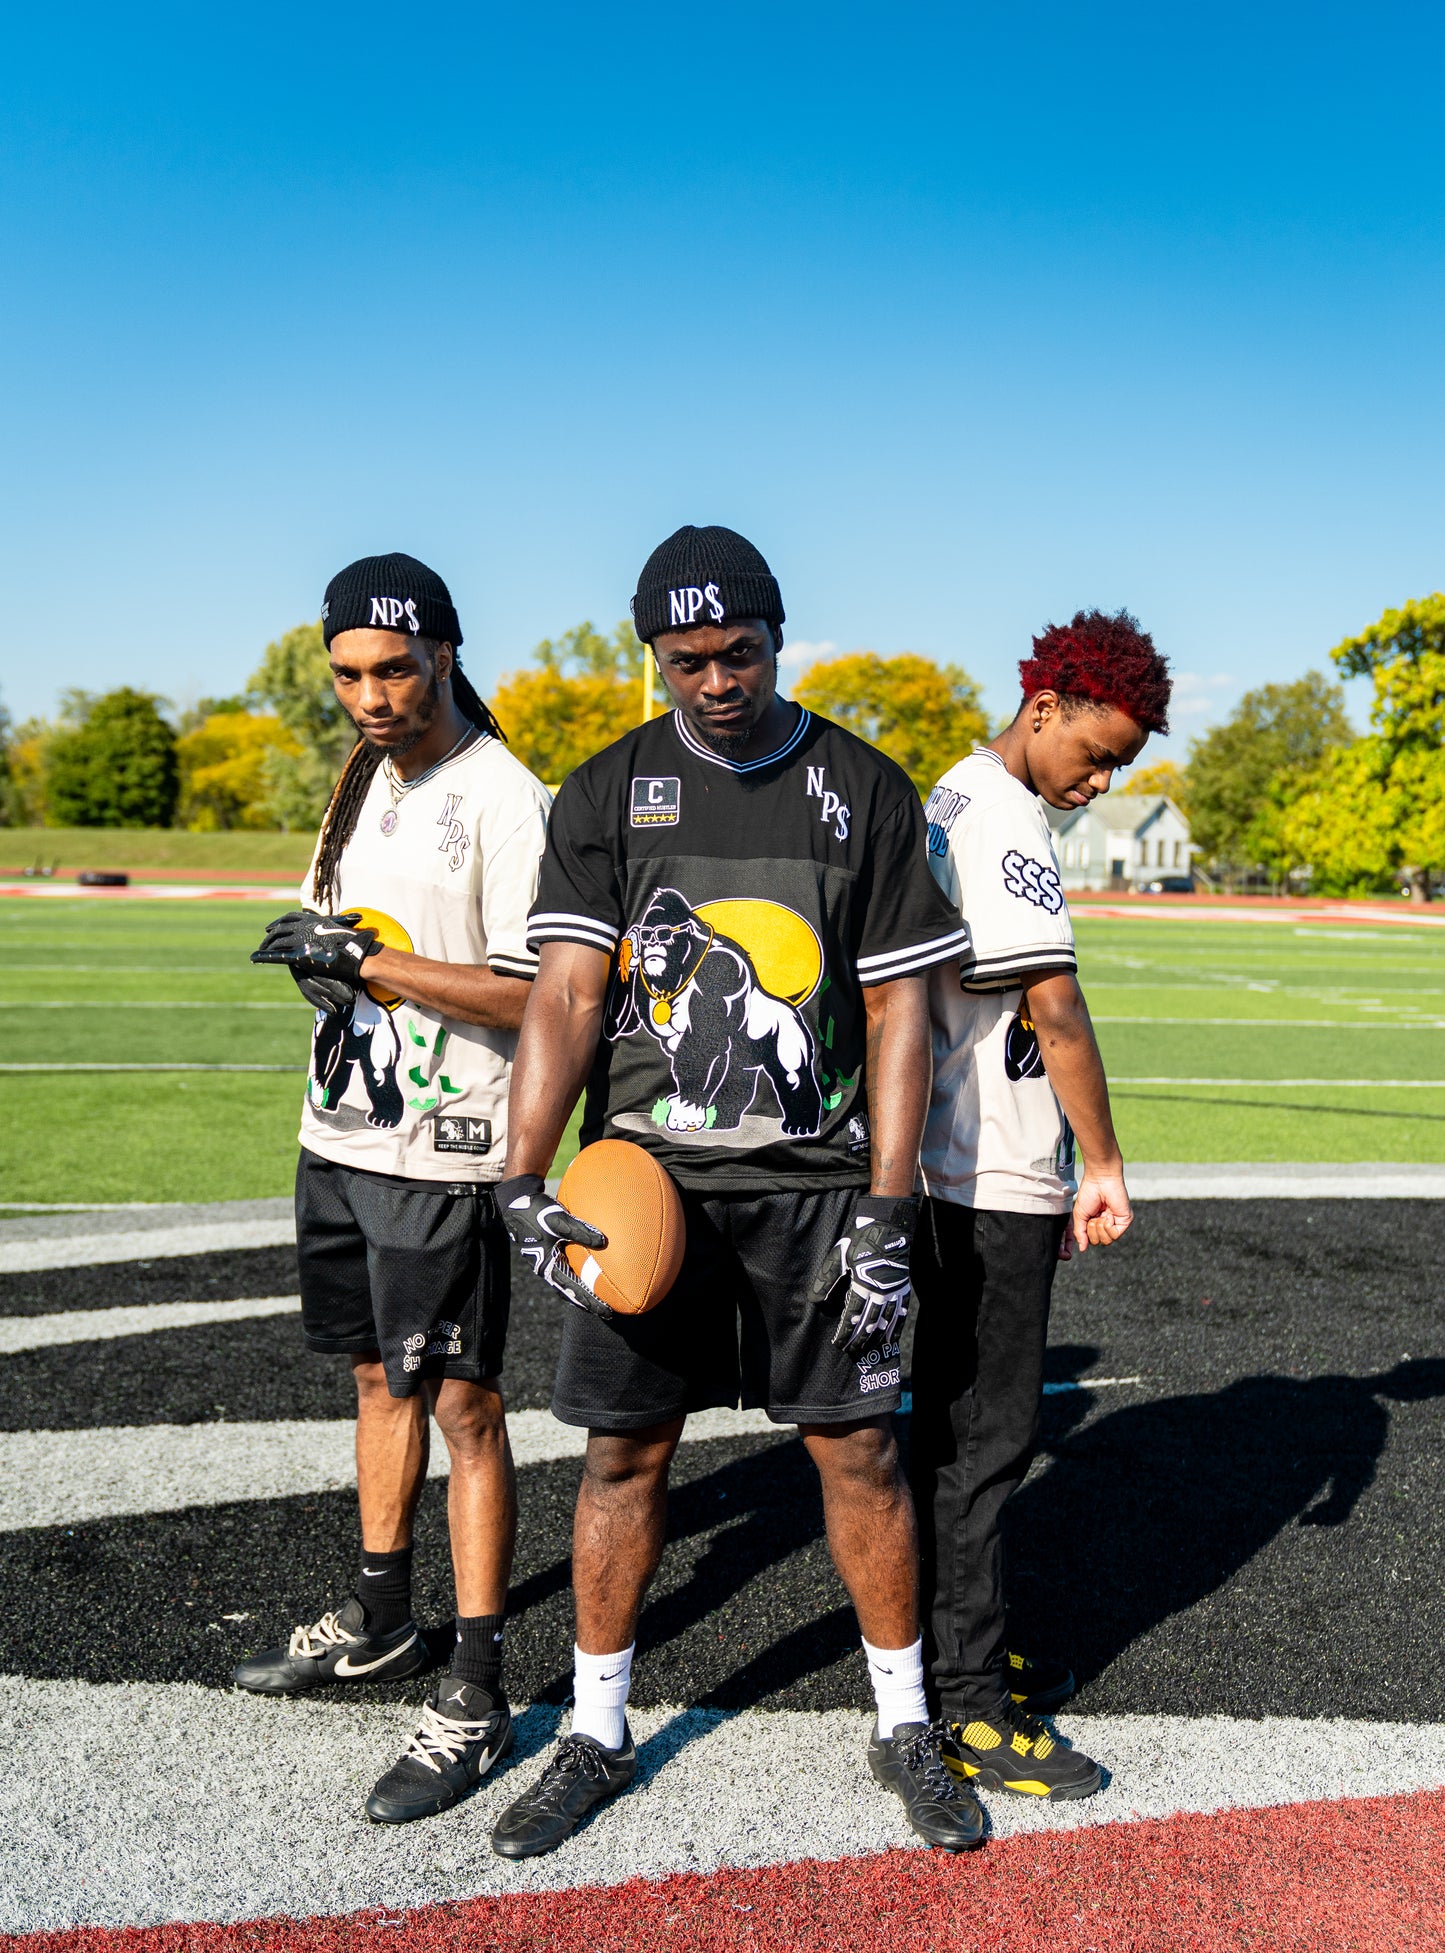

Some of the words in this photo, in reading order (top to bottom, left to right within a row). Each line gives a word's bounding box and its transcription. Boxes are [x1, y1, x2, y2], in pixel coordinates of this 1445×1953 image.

[668, 581, 725, 626] NP$
[369, 597, 420, 637] NP$
[648, 781, 664, 804] C
[469, 1121, 485, 1140] M
[403, 1333, 426, 1354] NO
[856, 1349, 881, 1374] NO
[860, 1368, 900, 1393] $HOR
